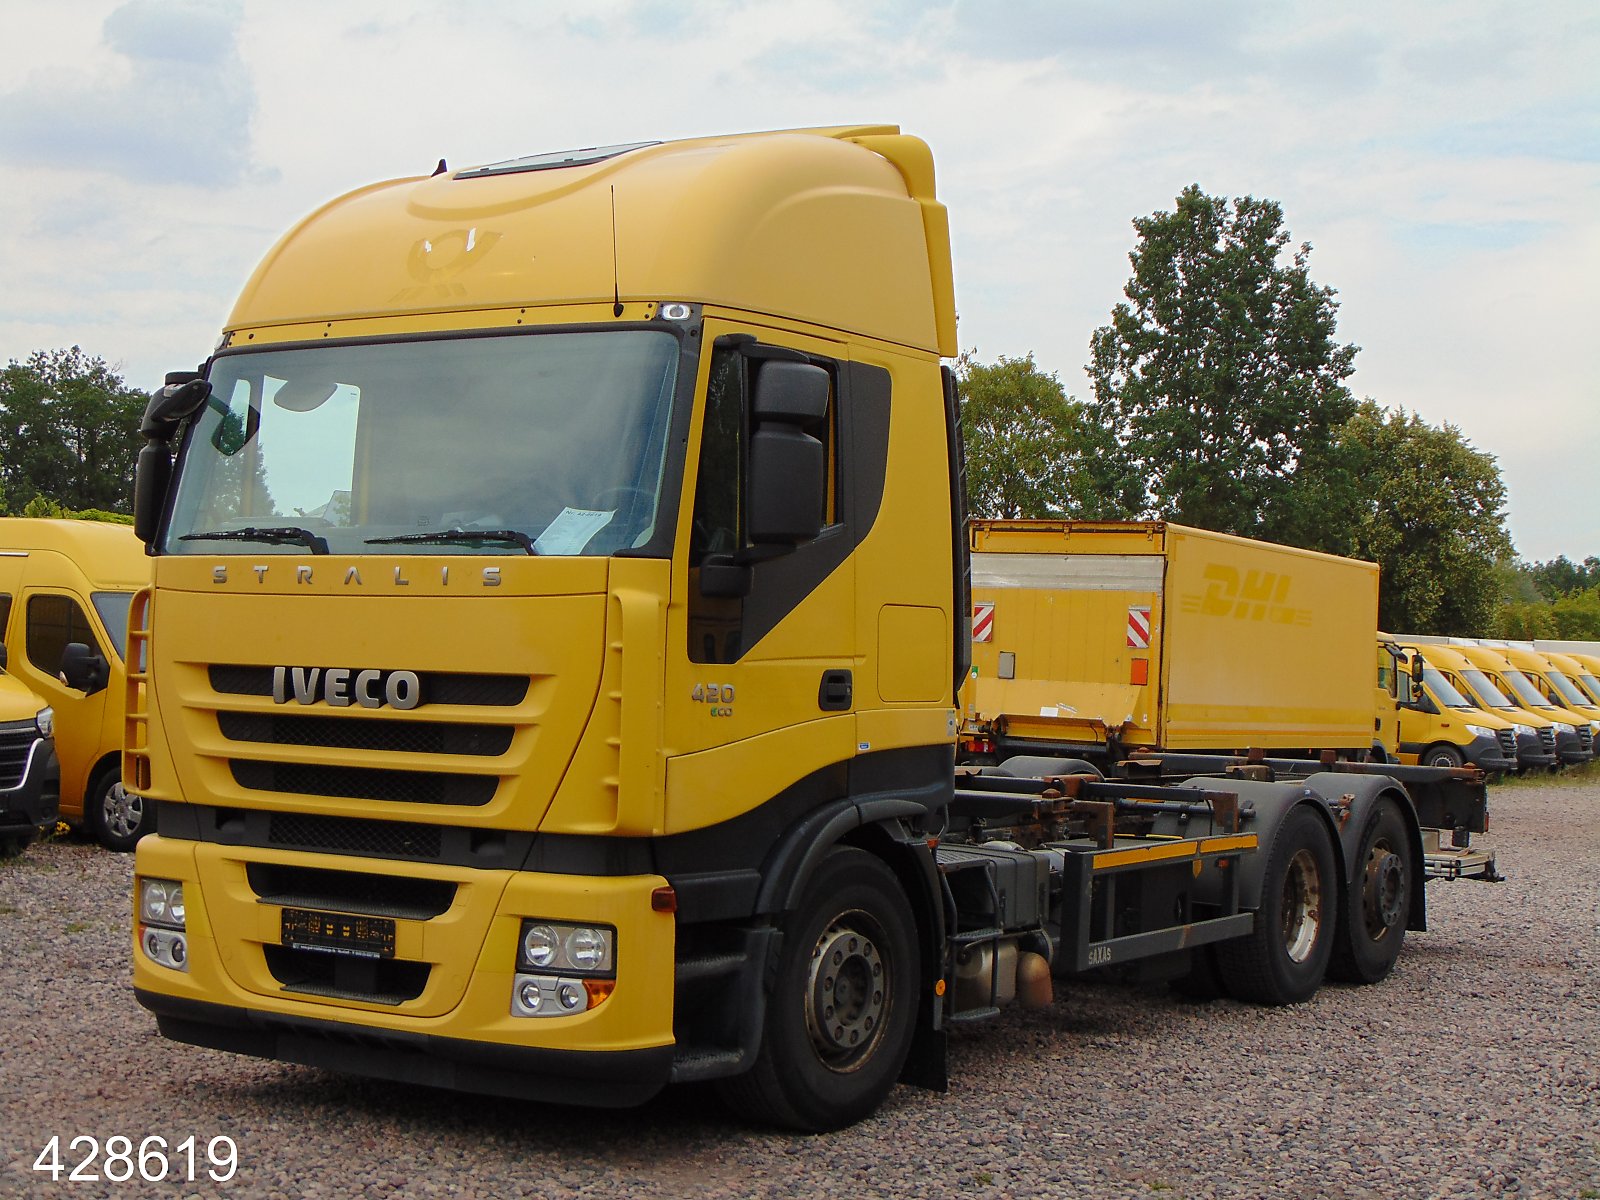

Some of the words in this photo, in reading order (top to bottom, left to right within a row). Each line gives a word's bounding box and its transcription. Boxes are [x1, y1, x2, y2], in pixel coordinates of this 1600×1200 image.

[212, 565, 502, 587] STRALIS
[1200, 562, 1297, 626] DHL
[272, 666, 420, 710] IVECO
[691, 682, 735, 703] 420
